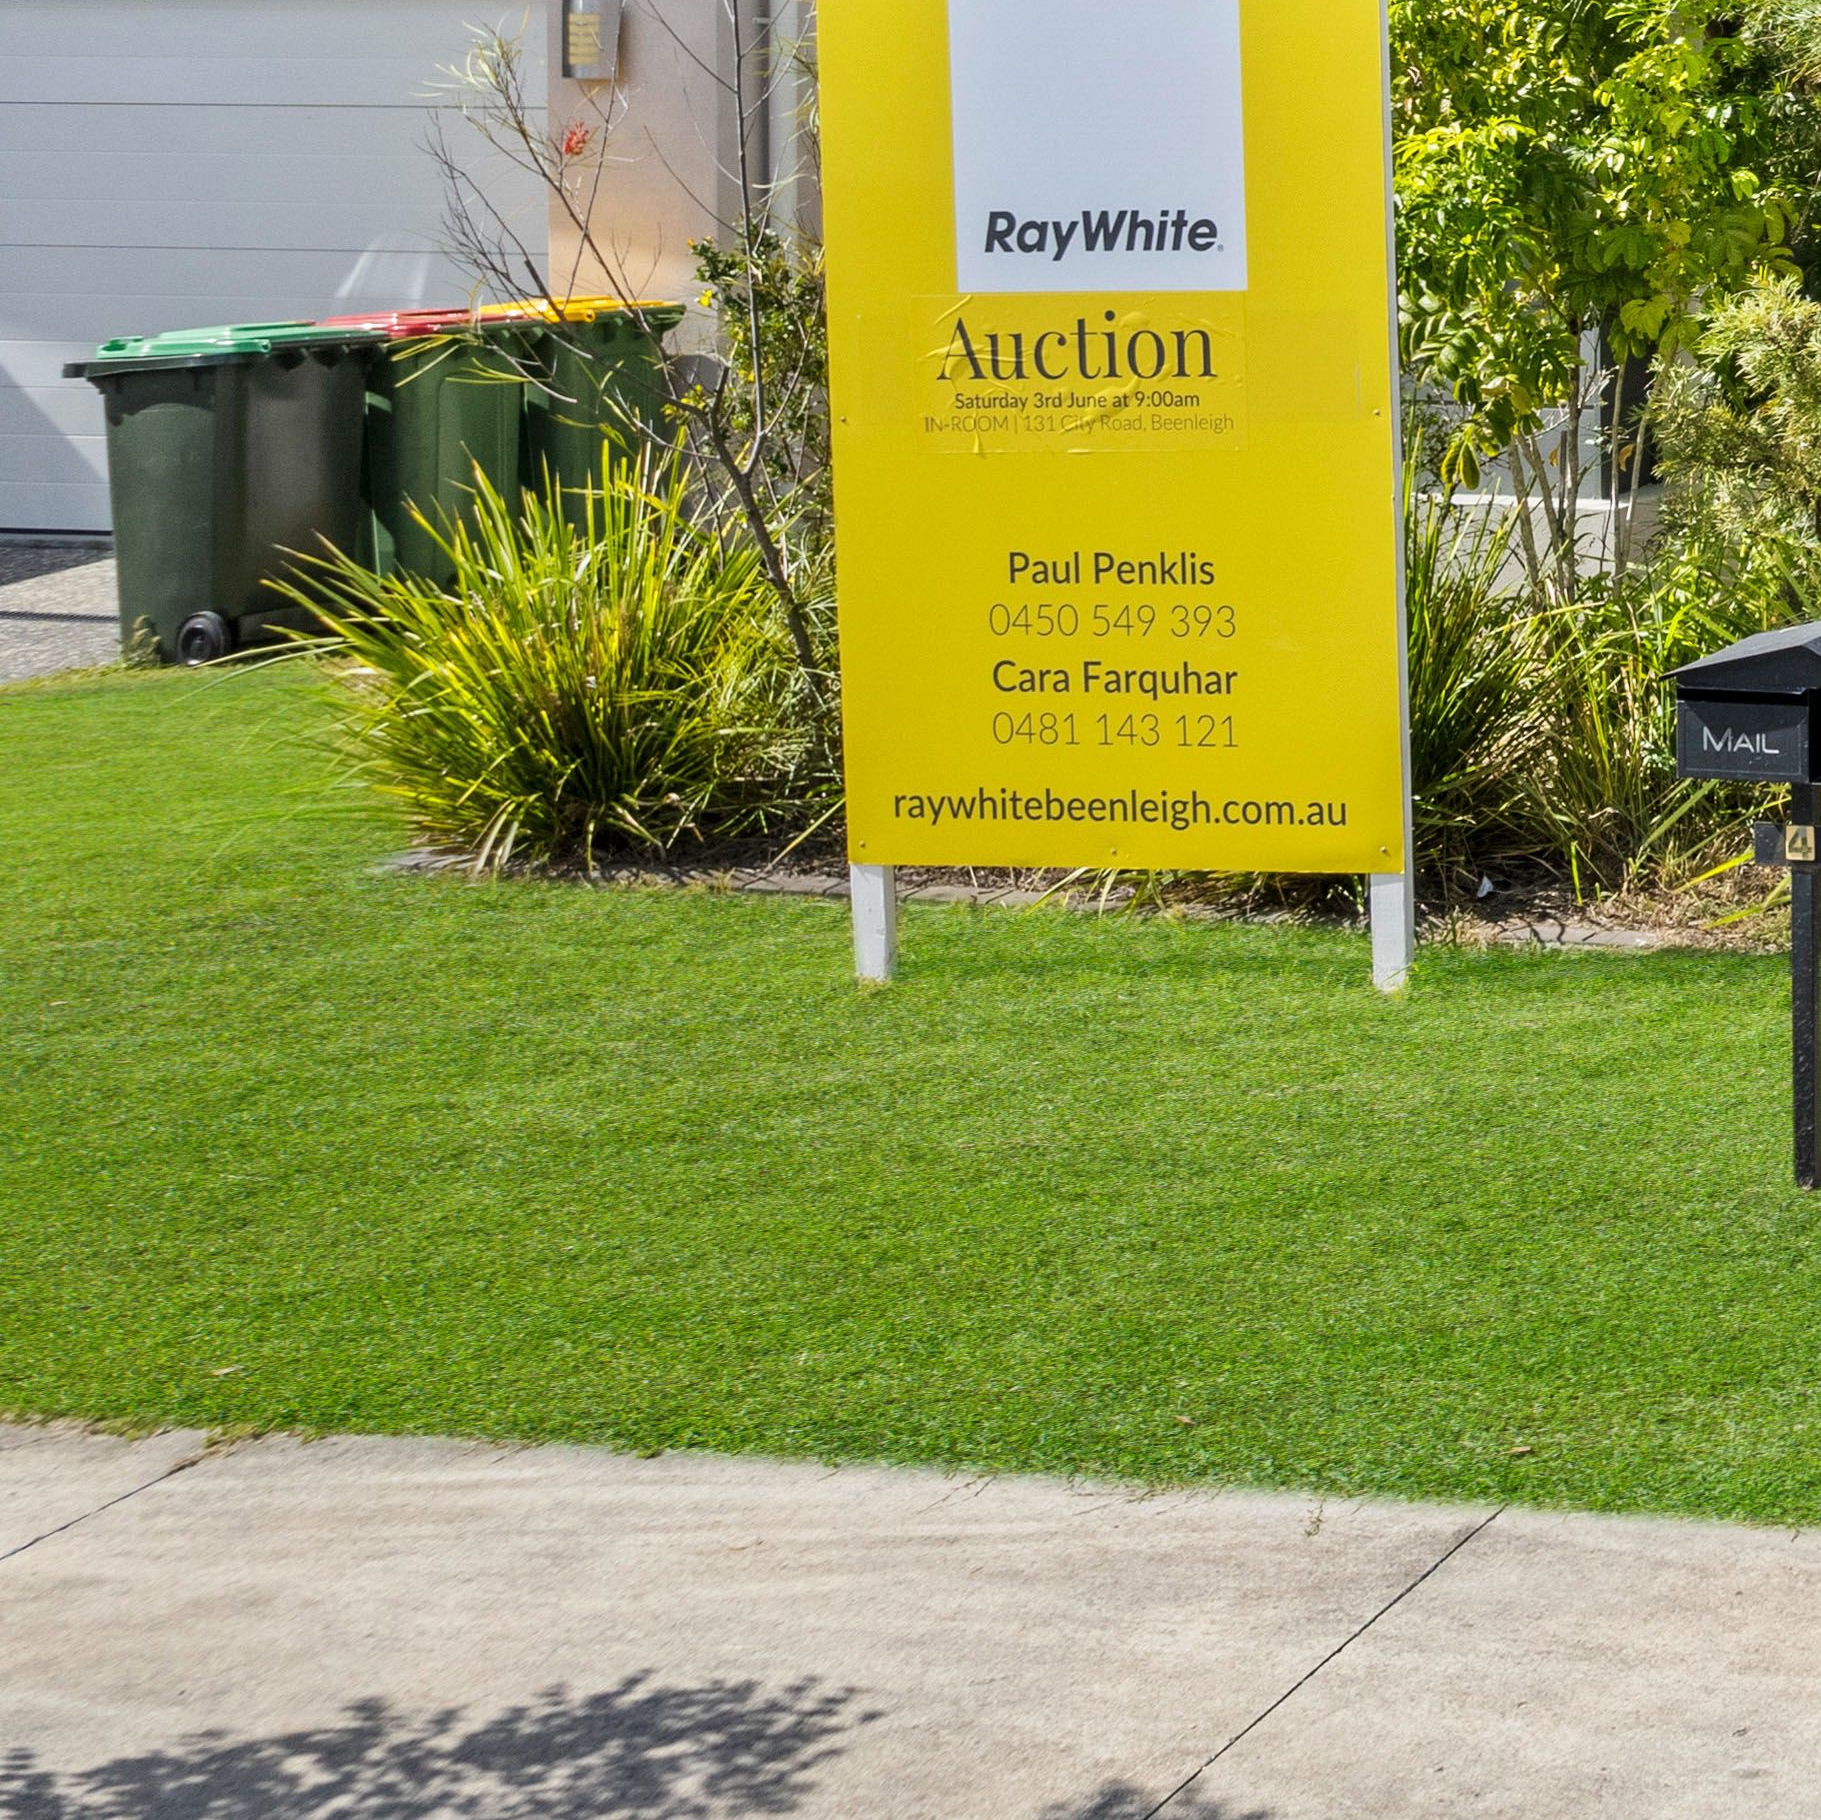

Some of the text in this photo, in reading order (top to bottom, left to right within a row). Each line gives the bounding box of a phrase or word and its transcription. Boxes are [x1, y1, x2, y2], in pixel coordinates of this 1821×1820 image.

[936, 309, 1218, 380] Auction
[955, 390, 1200, 412] Saturday 3rd June at 9:00am
[924, 414, 1009, 433] IN-ROOM
[1024, 414, 1056, 432] 131
[1060, 414, 1096, 435] City
[1101, 414, 1146, 432] Road,
[1151, 413, 1234, 433] Beenleigh
[1008, 551, 1215, 586] Paul Penklis
[989, 603, 1237, 638] 0450 549 393
[992, 660, 1238, 701] Cara Farquhar
[992, 711, 1239, 748] 0481 143 121
[893, 787, 1347, 831] raywhitebeenleigh.com.au
[1787, 827, 1812, 857] 4
